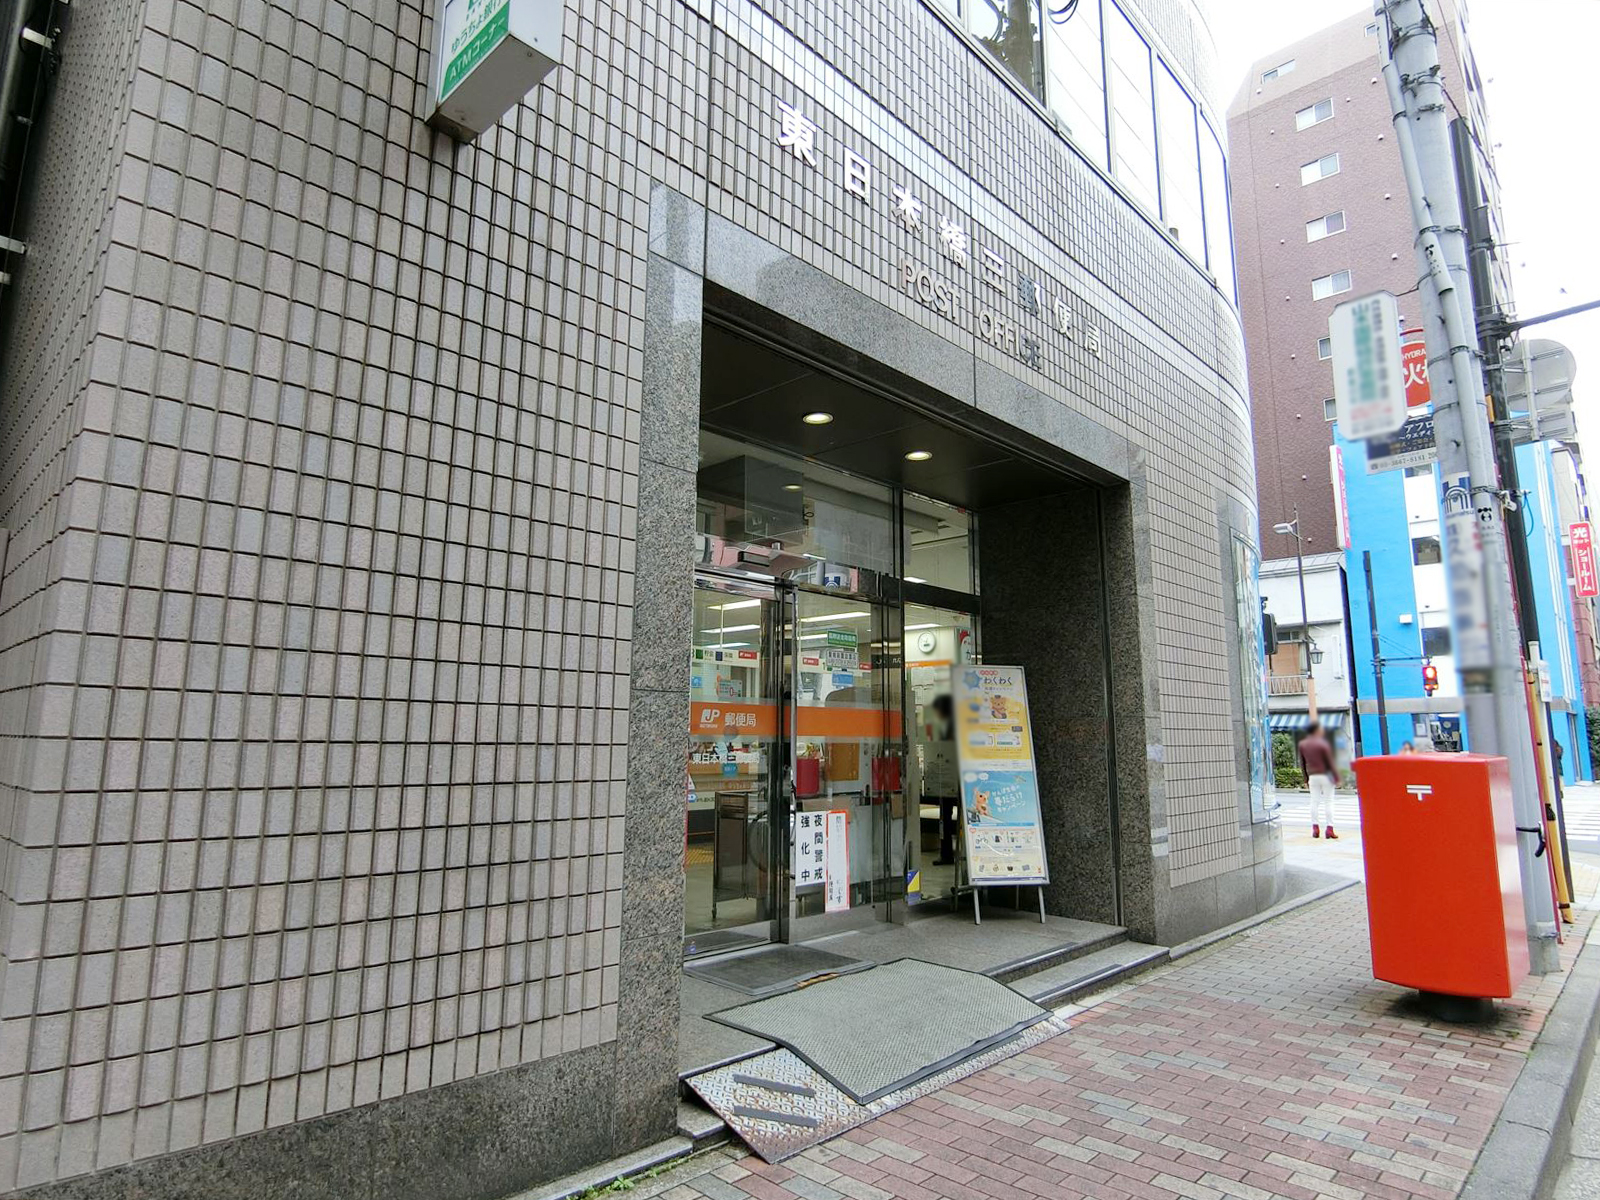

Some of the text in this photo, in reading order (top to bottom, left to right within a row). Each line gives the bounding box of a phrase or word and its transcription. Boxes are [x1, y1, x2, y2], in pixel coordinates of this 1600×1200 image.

[449, 17, 506, 81] ATMコーナー
[776, 99, 1101, 359] 東日本橋三郵便局
[899, 257, 1043, 370] POST OFFICE
[1402, 347, 1426, 360] HYDRA
[1404, 420, 1434, 434] アフロ
[1572, 526, 1588, 539] 光
[1577, 549, 1592, 591] ショールーム
[984, 676, 1012, 686] わくわく
[724, 712, 757, 727] 郵便局
[801, 815, 810, 882] 強化中
[814, 814, 824, 881] 夜間警戒
